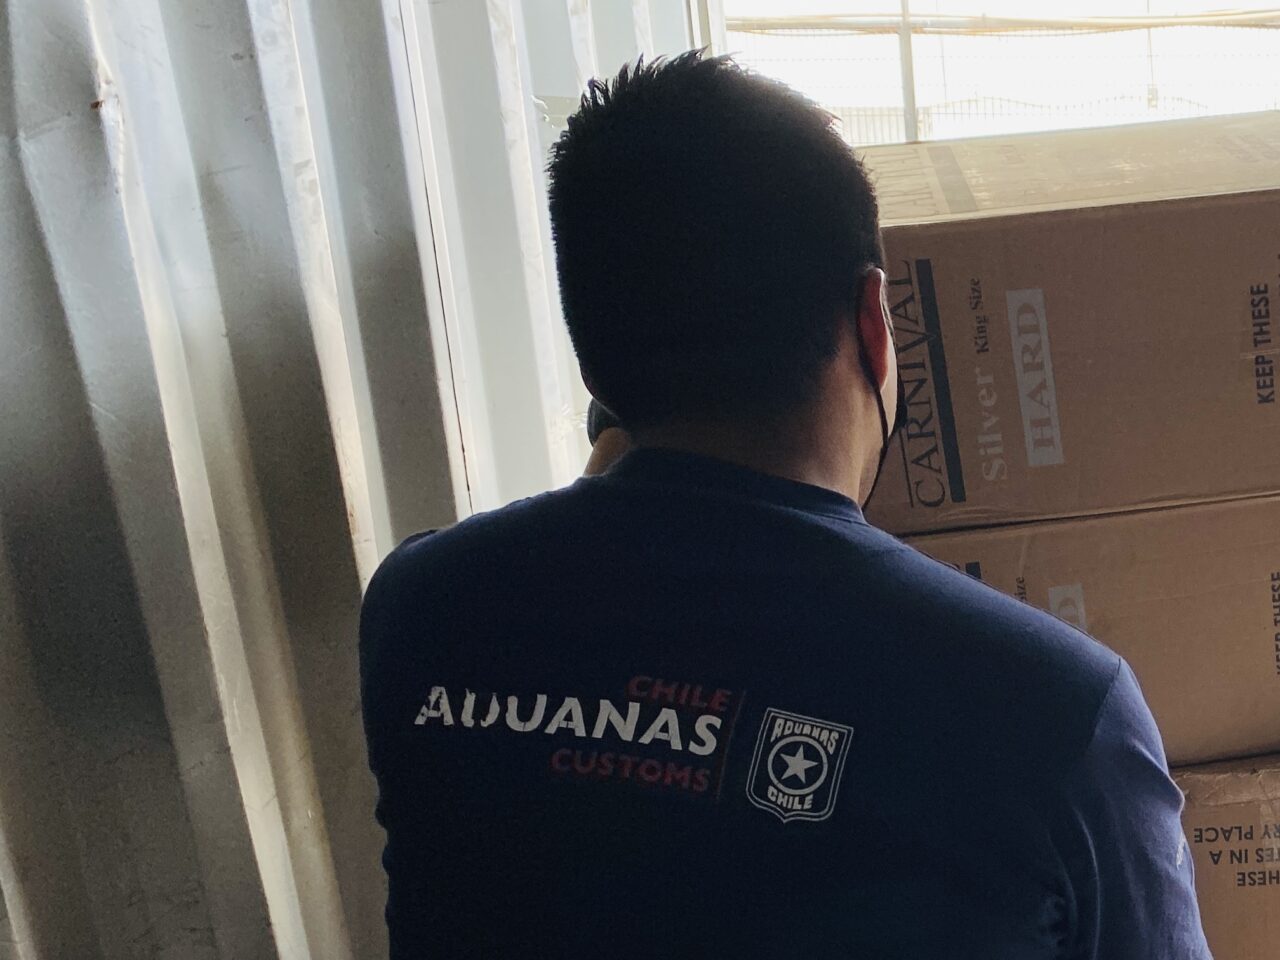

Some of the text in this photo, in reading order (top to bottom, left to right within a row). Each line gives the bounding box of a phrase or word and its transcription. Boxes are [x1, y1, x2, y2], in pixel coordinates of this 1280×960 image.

[1250, 283, 1275, 404] KEEP THESE
[889, 260, 946, 508] CARNIVAL
[970, 277, 1008, 482] Silver King Size
[1014, 302, 1056, 454] HARD
[626, 674, 733, 713] CHILE
[769, 716, 841, 757] ADUANAS
[550, 747, 711, 794] CUSTOMS
[765, 784, 815, 811] CHILE
[1194, 826, 1254, 843] PLACE
[1209, 850, 1222, 865] A
[1229, 849, 1248, 865] IN
